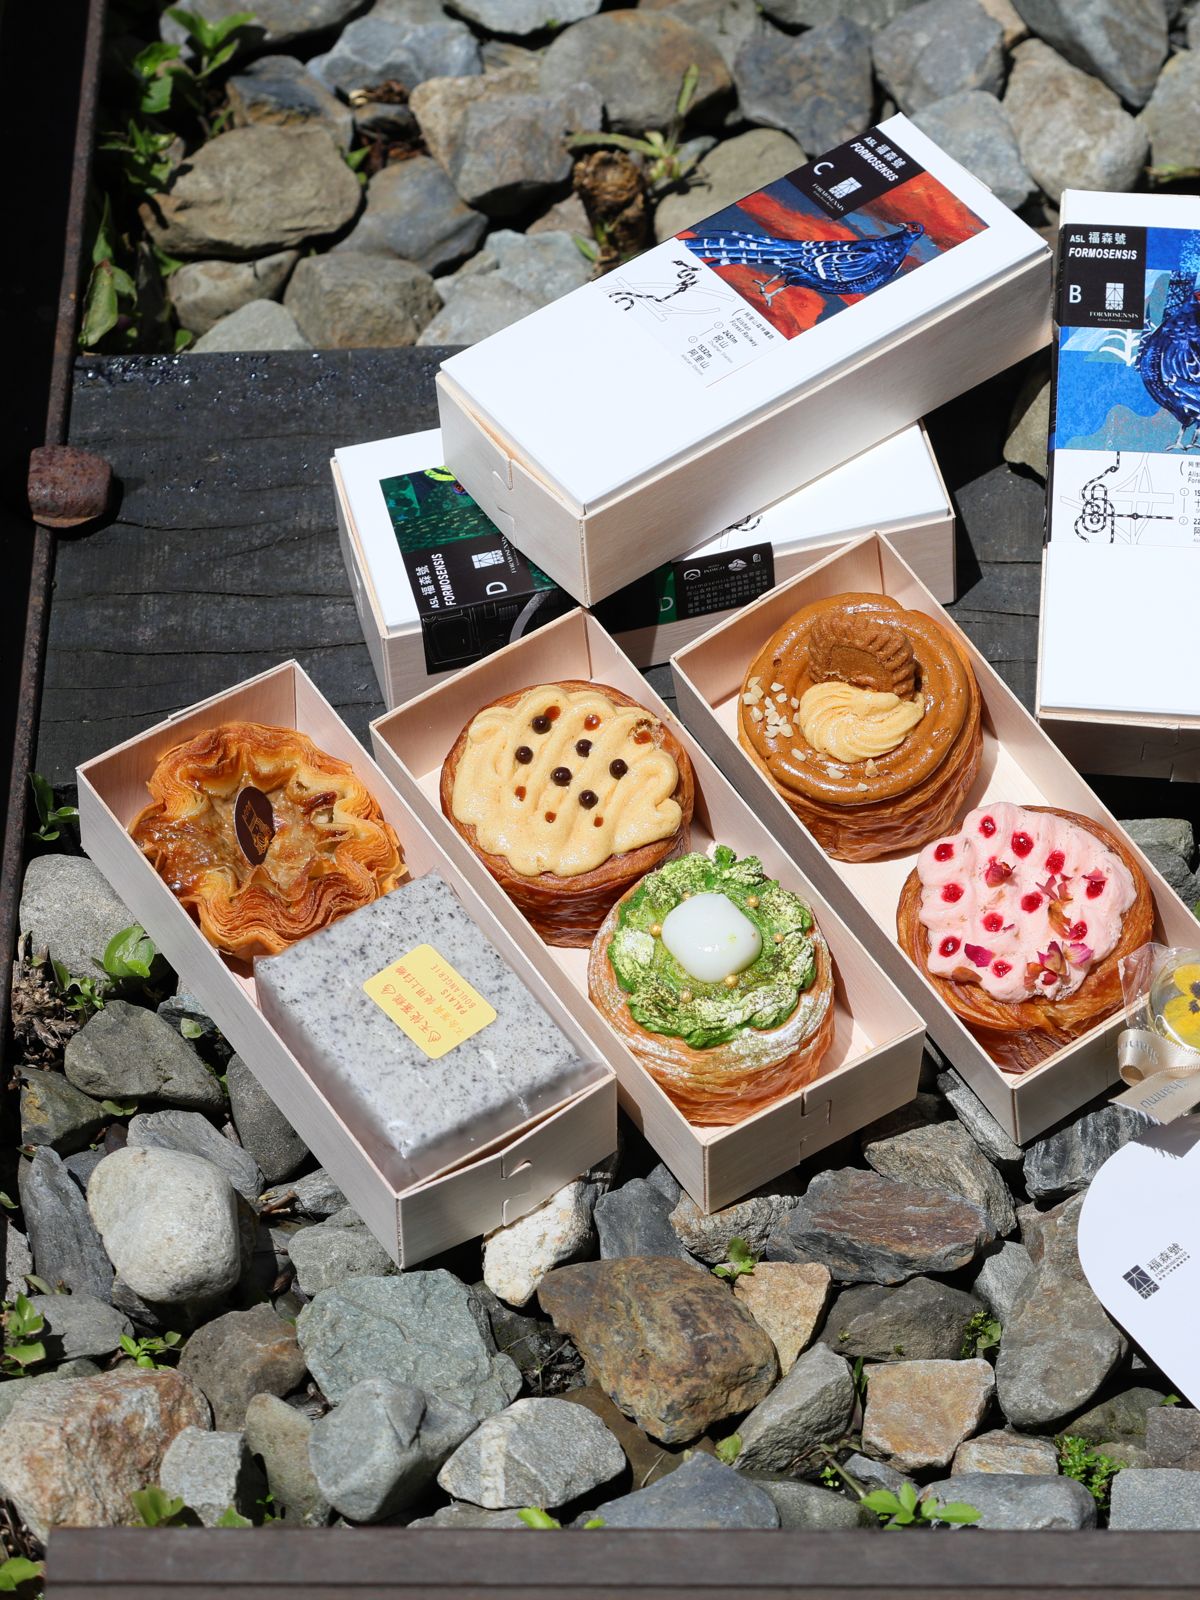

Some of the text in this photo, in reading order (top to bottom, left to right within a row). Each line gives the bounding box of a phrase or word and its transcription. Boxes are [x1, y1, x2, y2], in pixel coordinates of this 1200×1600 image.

[850, 143, 898, 181] FORMOSENSIS
[864, 137, 906, 169] ASL 福森號
[814, 162, 834, 175] C
[1070, 232, 1126, 245] ASL 福森號
[1068, 247, 1137, 260] FORMOSENSIS
[1069, 284, 1081, 303] B
[415, 565, 440, 608] ASL 福森號
[431, 553, 457, 606] FORMOSENSIS
[486, 581, 508, 596] D
[430, 964, 477, 1009] BOULANGERIE
[392, 995, 432, 1034] 天使蛋糕
[440, 988, 468, 1015] PALAIS
[1147, 1243, 1183, 1272] 福森號
